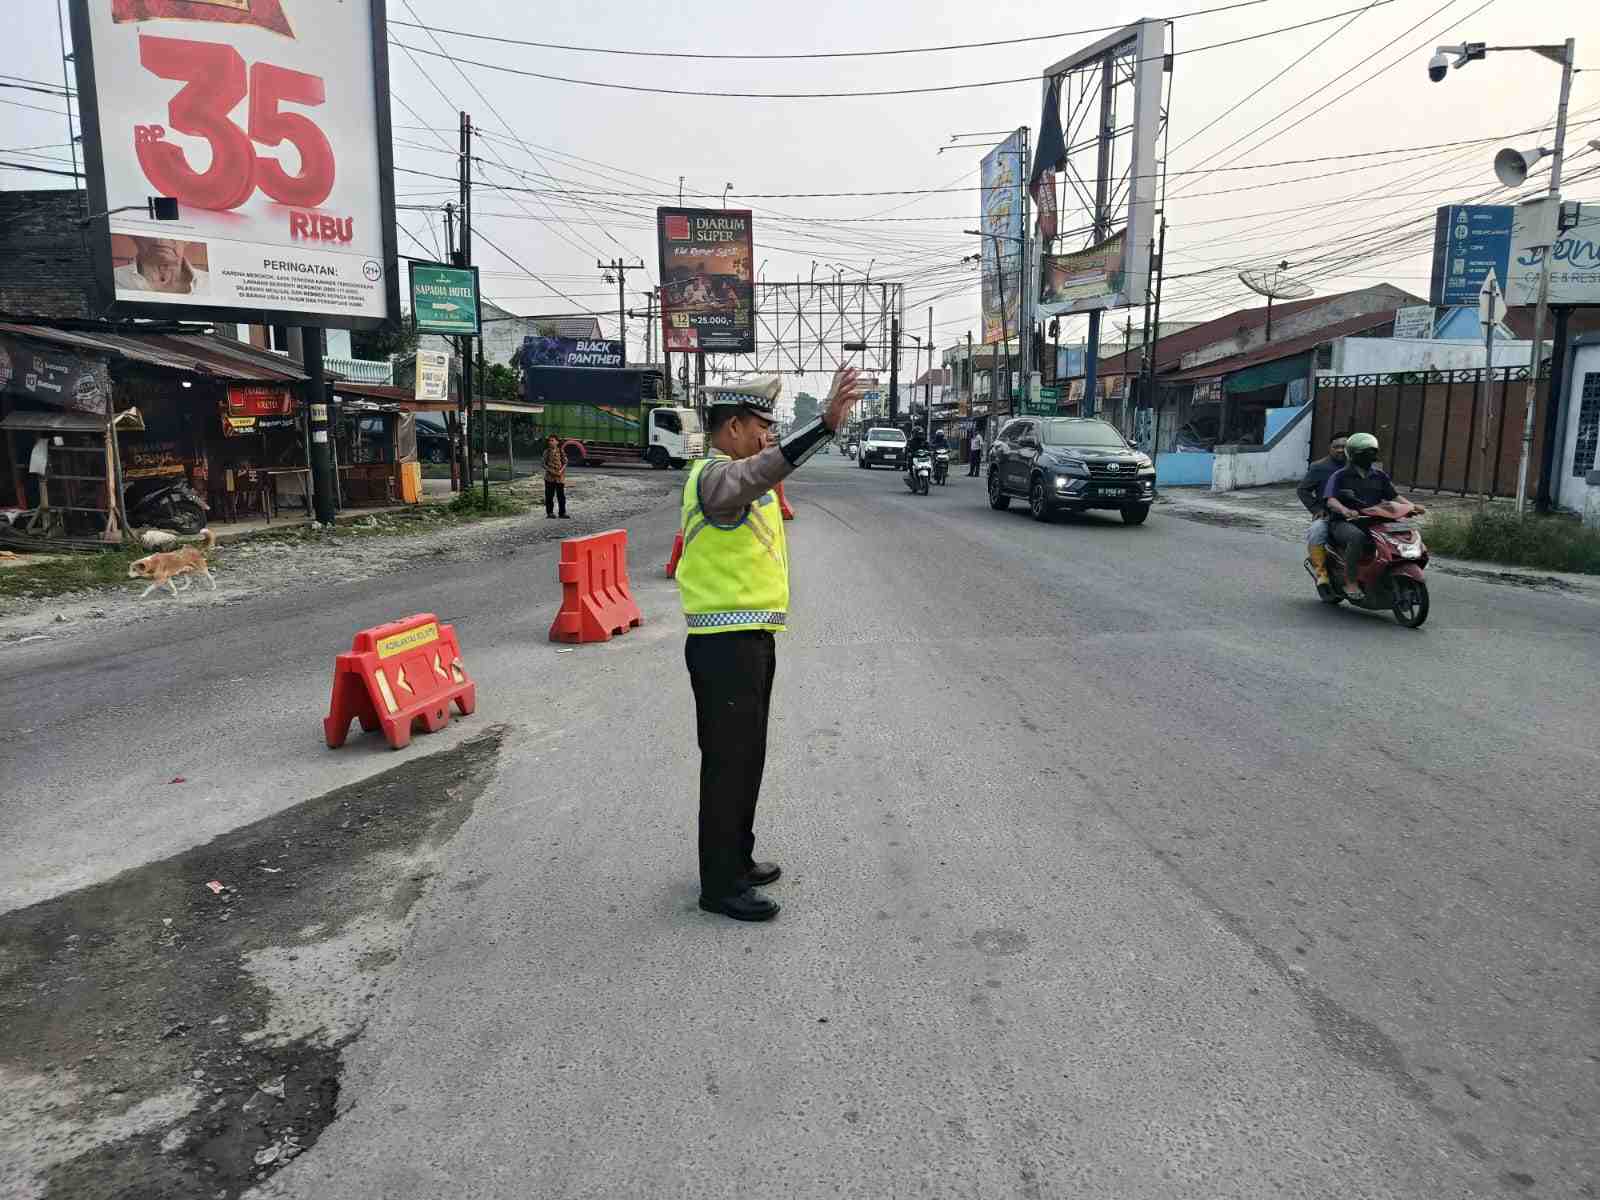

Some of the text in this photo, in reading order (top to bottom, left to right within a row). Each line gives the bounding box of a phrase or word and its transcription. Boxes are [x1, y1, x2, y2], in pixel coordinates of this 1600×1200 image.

[134, 35, 336, 210] 35
[289, 211, 354, 242] RIBU
[697, 230, 733, 241] SUPER
[263, 259, 339, 277] PERINGATAN:
[449, 287, 472, 297] HOTEL
[576, 341, 610, 353] BLACK
[567, 353, 621, 366] PANTHER
